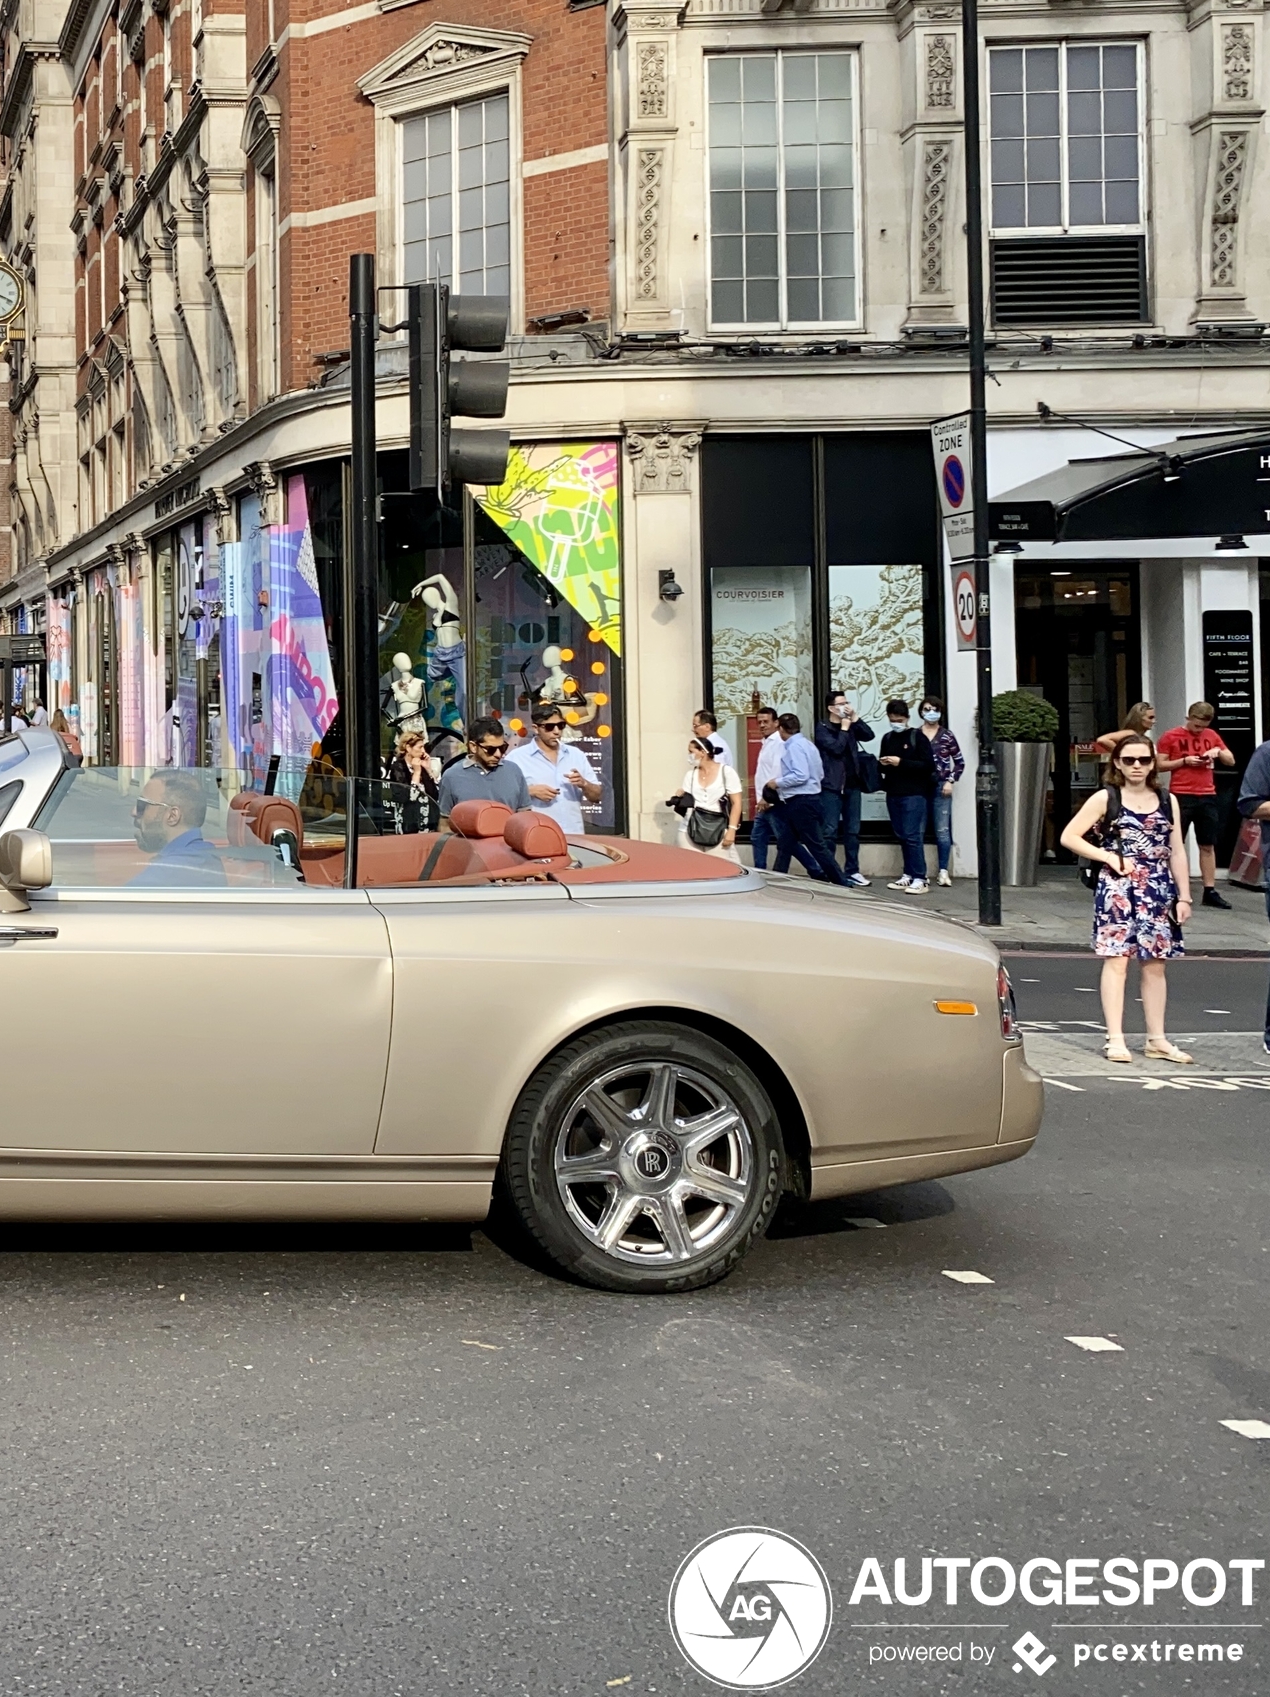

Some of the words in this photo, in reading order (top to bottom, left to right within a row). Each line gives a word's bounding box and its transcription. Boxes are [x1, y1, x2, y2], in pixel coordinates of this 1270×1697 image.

[933, 418, 967, 436] Controlled
[939, 435, 962, 452] ZONE
[716, 590, 784, 599] COURVOISIER
[959, 592, 974, 621] 20
